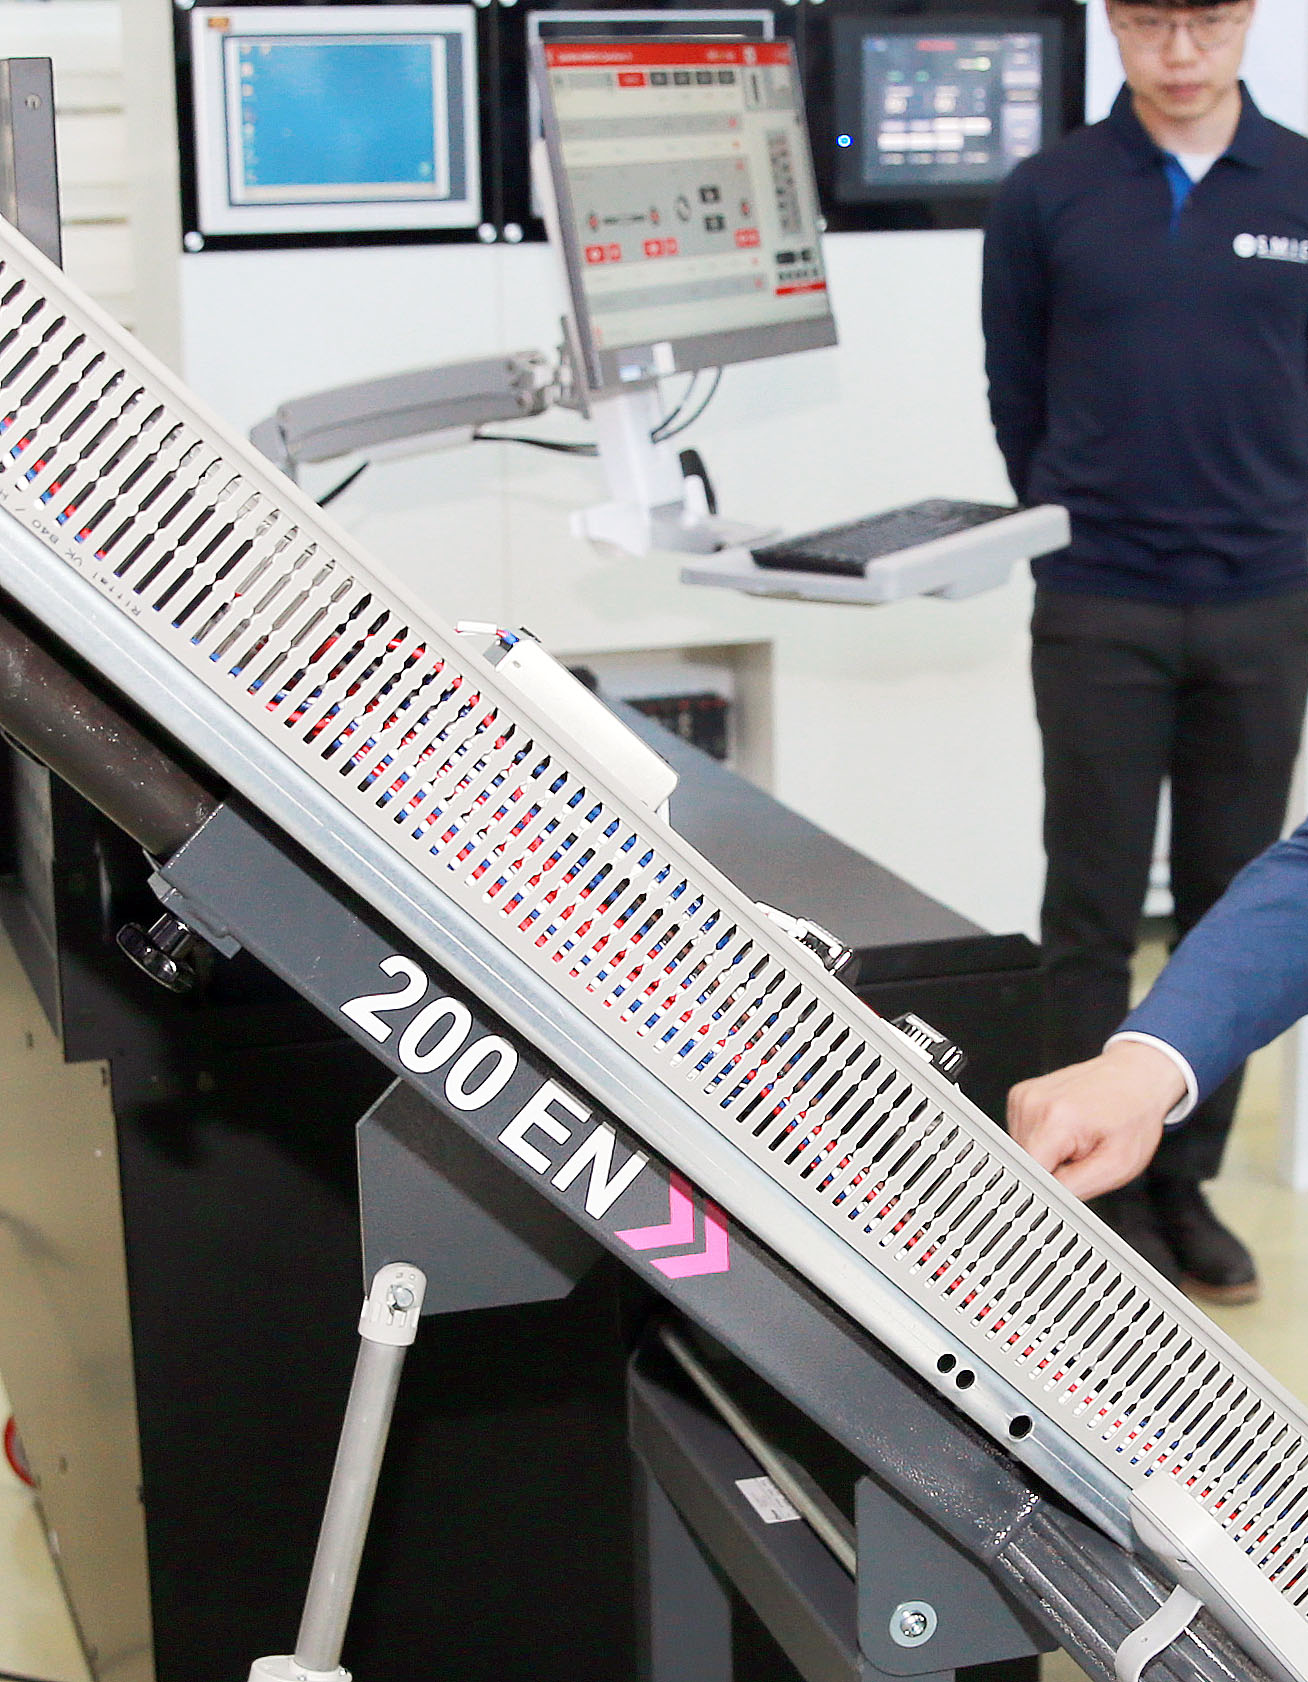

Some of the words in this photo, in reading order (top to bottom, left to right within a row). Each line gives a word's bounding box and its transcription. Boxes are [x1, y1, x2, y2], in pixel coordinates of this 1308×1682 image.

[32, 519, 59, 544] B40
[65, 549, 83, 567] VK
[340, 955, 518, 1111] 200
[499, 1078, 649, 1220] EN
